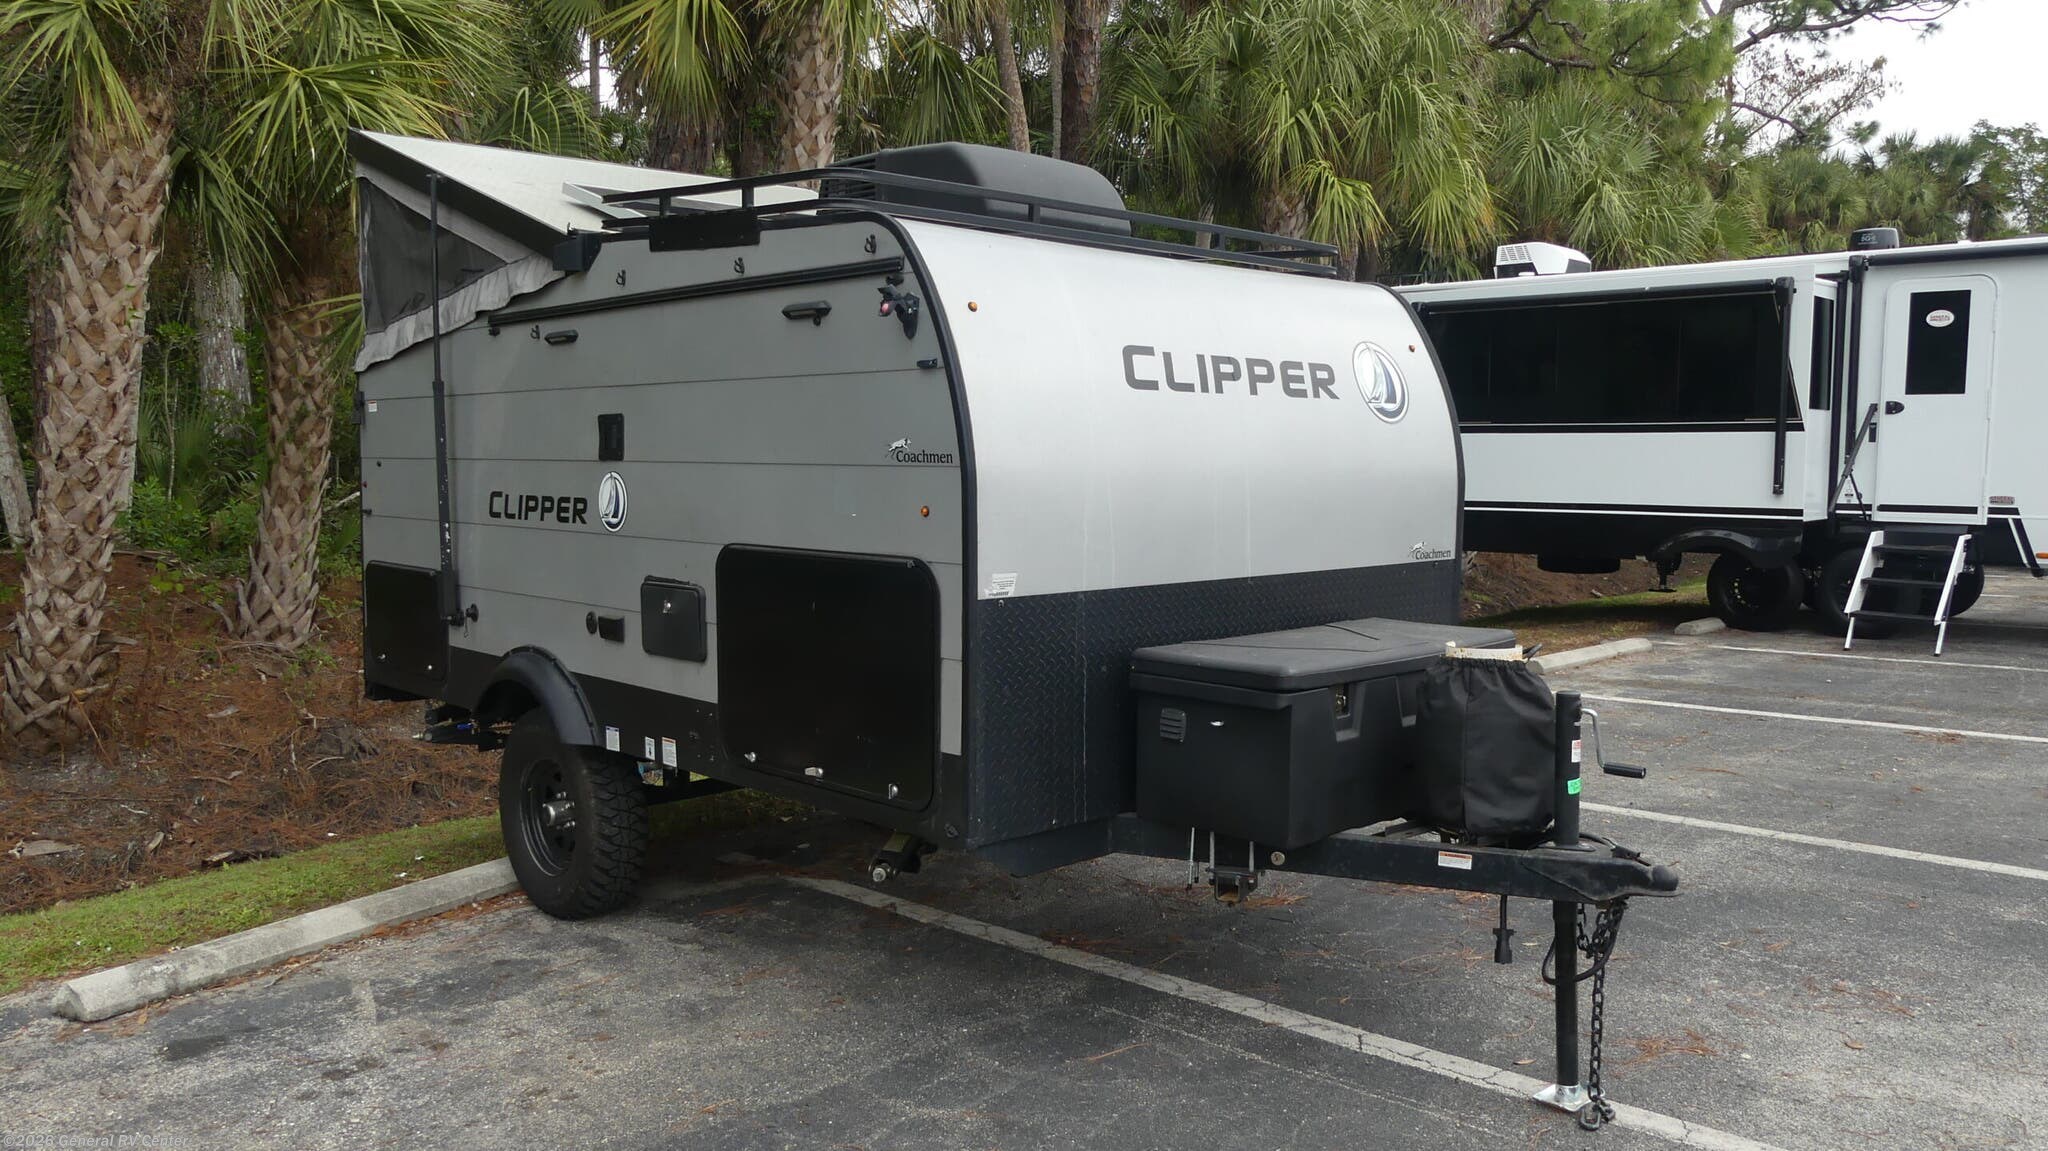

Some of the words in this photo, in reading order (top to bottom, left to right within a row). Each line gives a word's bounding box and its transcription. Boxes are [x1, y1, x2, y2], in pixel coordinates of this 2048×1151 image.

[1122, 344, 1340, 400] CLIPPER
[896, 449, 953, 464] Coachmen
[488, 490, 588, 525] CLIPPER
[1415, 548, 1451, 560] Coachmen
